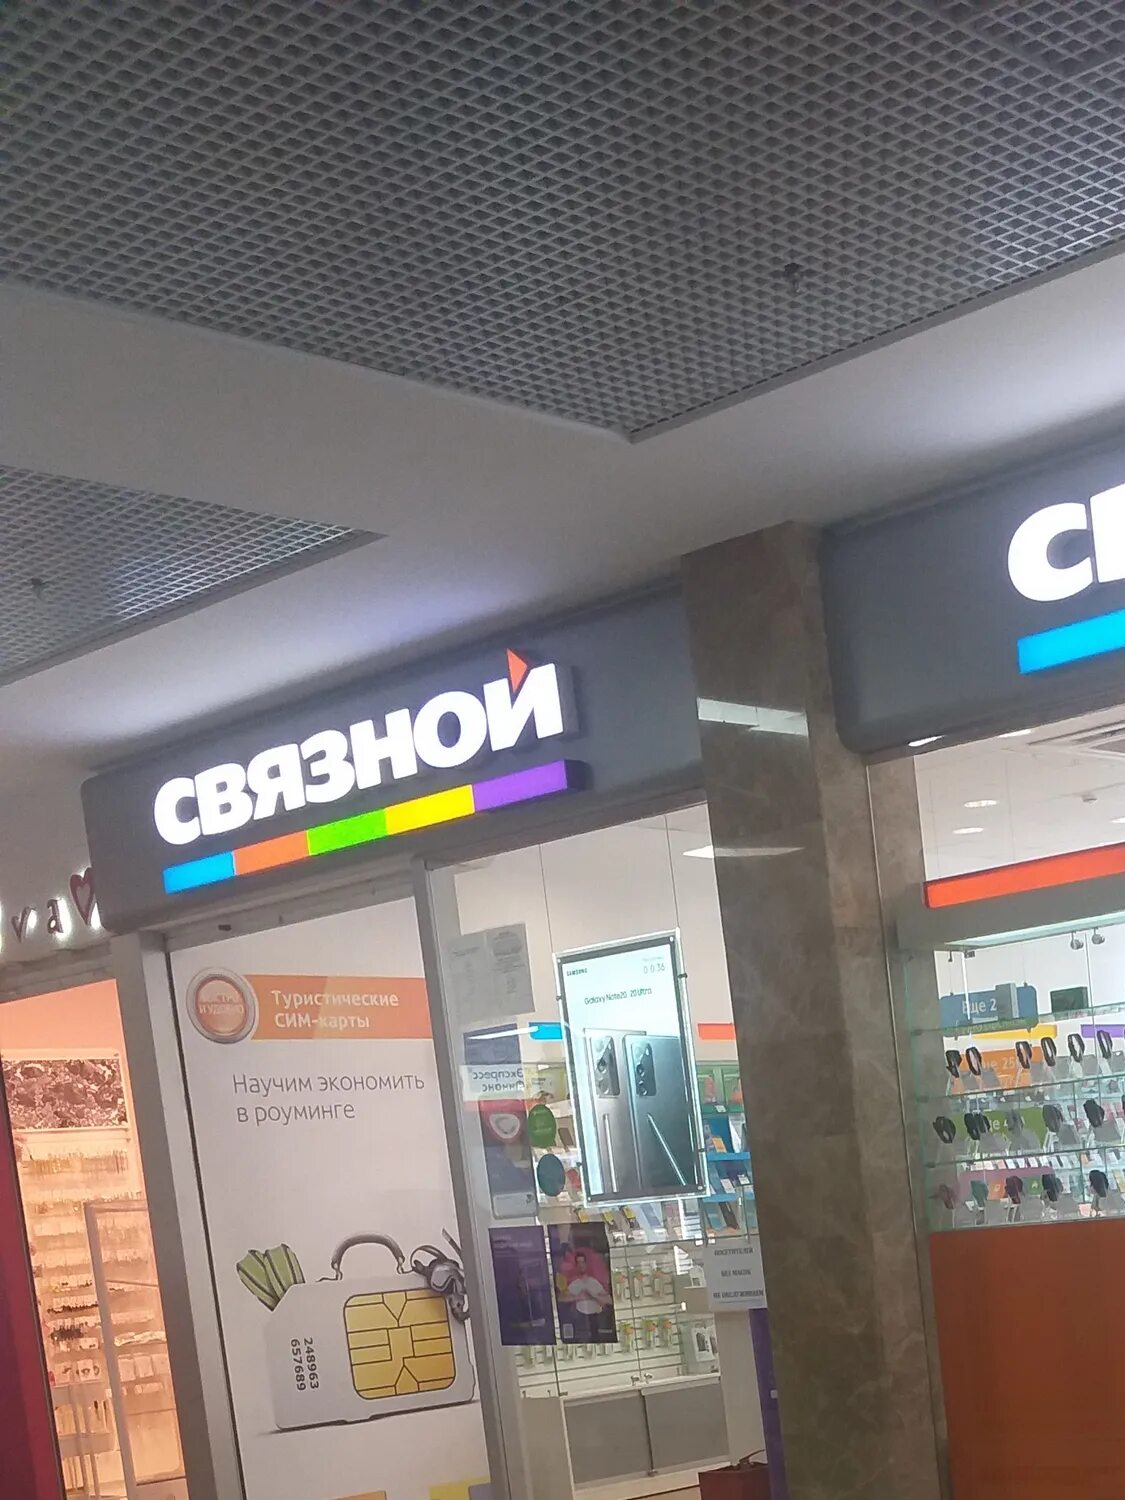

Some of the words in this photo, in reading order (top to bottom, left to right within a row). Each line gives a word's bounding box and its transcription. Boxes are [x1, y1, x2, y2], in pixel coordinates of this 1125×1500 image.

[153, 648, 565, 846] СВЯЗНОЙ
[271, 989, 400, 1010] Туристические
[274, 1013, 370, 1032] СИМ-карты
[233, 1075, 312, 1097] Научим
[319, 1074, 425, 1092] экономить
[237, 1107, 248, 1123] в
[255, 1104, 356, 1126] роуминге
[290, 1338, 306, 1391] 657689
[303, 1337, 319, 1389] 248963
